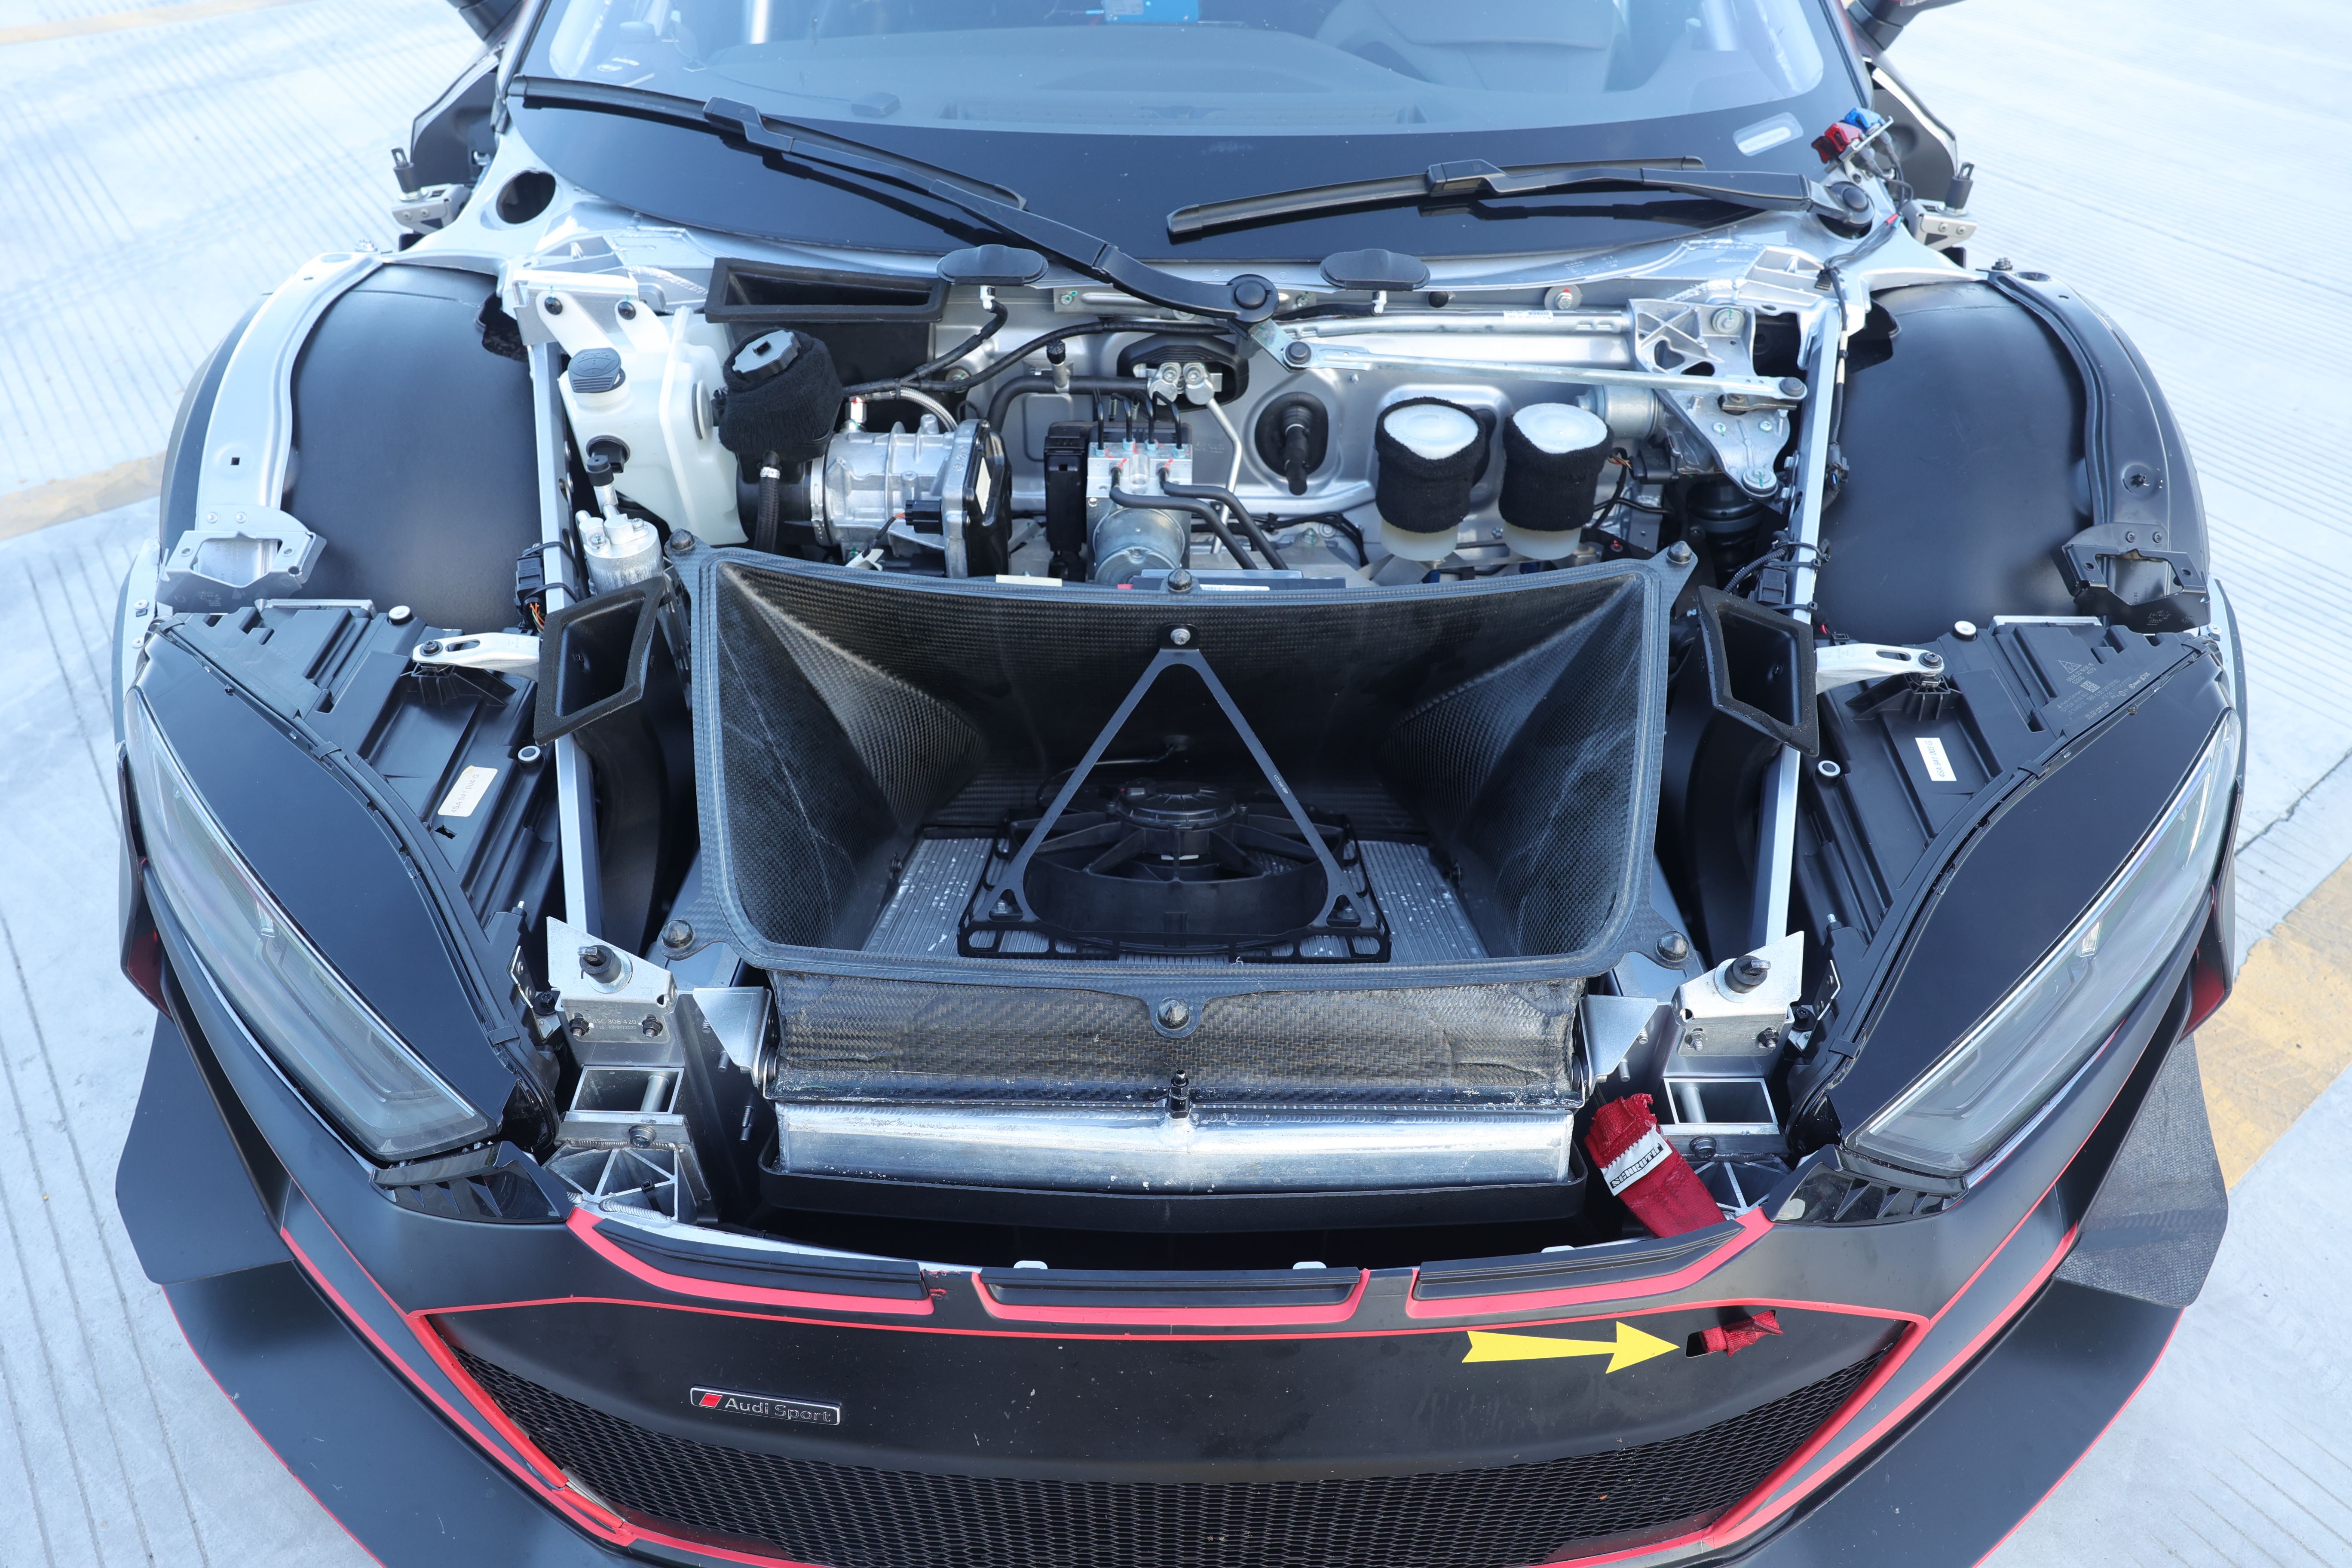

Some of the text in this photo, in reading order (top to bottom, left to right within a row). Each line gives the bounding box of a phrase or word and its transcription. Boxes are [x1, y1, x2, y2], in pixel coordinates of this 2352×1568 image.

[1927, 746, 1936, 755] 003
[1931, 757, 1941, 766] 941
[1936, 767, 1945, 777] 4SA
[451, 802, 462, 813] 4SA
[1610, 1143, 1664, 1189] SCHROTH
[725, 1398, 831, 1422] Audi Sport
